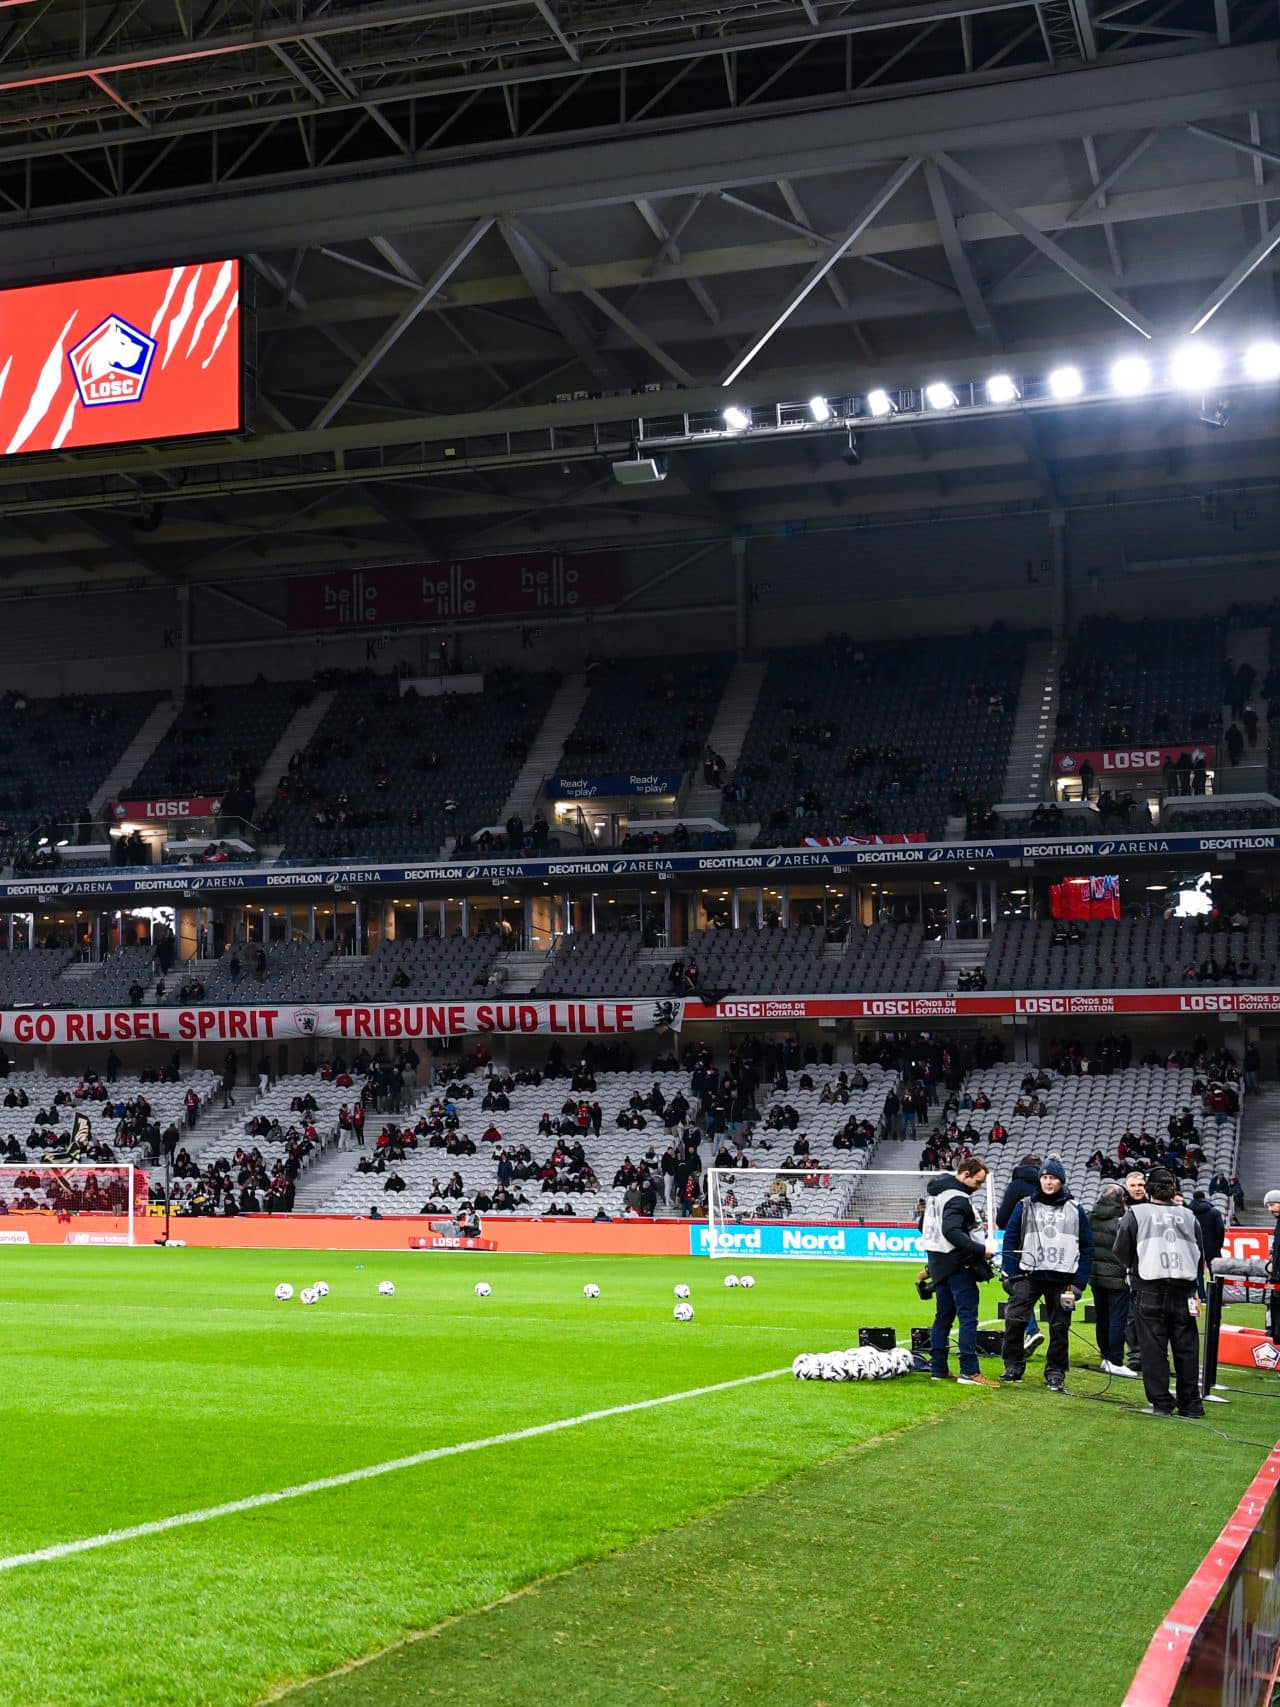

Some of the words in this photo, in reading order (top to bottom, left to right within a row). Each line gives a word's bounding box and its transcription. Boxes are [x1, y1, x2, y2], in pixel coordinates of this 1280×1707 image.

[90, 379, 134, 399] LOSC
[522, 557, 579, 587] hello
[325, 572, 377, 602] hello
[422, 565, 476, 595] hello
[1103, 751, 1161, 769] LOSC
[560, 779, 588, 788] Ready
[630, 775, 658, 784] Ready
[575, 786, 597, 797] play?
[645, 783, 668, 793] play?
[146, 801, 189, 817] LOSC
[1023, 843, 1094, 857] DECATHLON
[1119, 840, 1169, 853] ARENA
[1200, 837, 1275, 850] DECATHLON
[699, 857, 761, 869] DECATHLON
[784, 854, 830, 865] ARENA
[856, 850, 923, 863] DECATHLON
[947, 847, 994, 859] ARENA
[404, 868, 462, 880] DECATHLON
[482, 867, 524, 877] ARENA
[549, 863, 608, 875] DECATHLON
[629, 860, 673, 871] ARENA
[135, 879, 188, 890] DECATHLON
[206, 877, 244, 888] ARENA
[267, 874, 322, 885] DECATHLON
[341, 872, 381, 882] ARENA
[7, 884, 58, 895] DECATHLON
[76, 882, 113, 892] ARENA
[715, 1003, 761, 1017] LOSC
[863, 1001, 909, 1014] LOSC
[1015, 998, 1064, 1013] LOSC
[1071, 1004, 1114, 1012] DOTATION
[1180, 996, 1232, 1011] LOSC
[14, 1012, 56, 1042] GO
[65, 1012, 170, 1042] RIJSEL
[178, 1010, 279, 1040] SPIRIT
[335, 1005, 466, 1037] TRIBUNE
[476, 1005, 538, 1033] SUD
[549, 1004, 635, 1033] LILLE
[1151, 1213, 1185, 1226] LFP
[432, 1237, 460, 1246] LOSC
[700, 1229, 760, 1248] Nord
[783, 1230, 845, 1250] Nord
[1036, 1246, 1058, 1264] 38
[1160, 1251, 1179, 1270] 08
